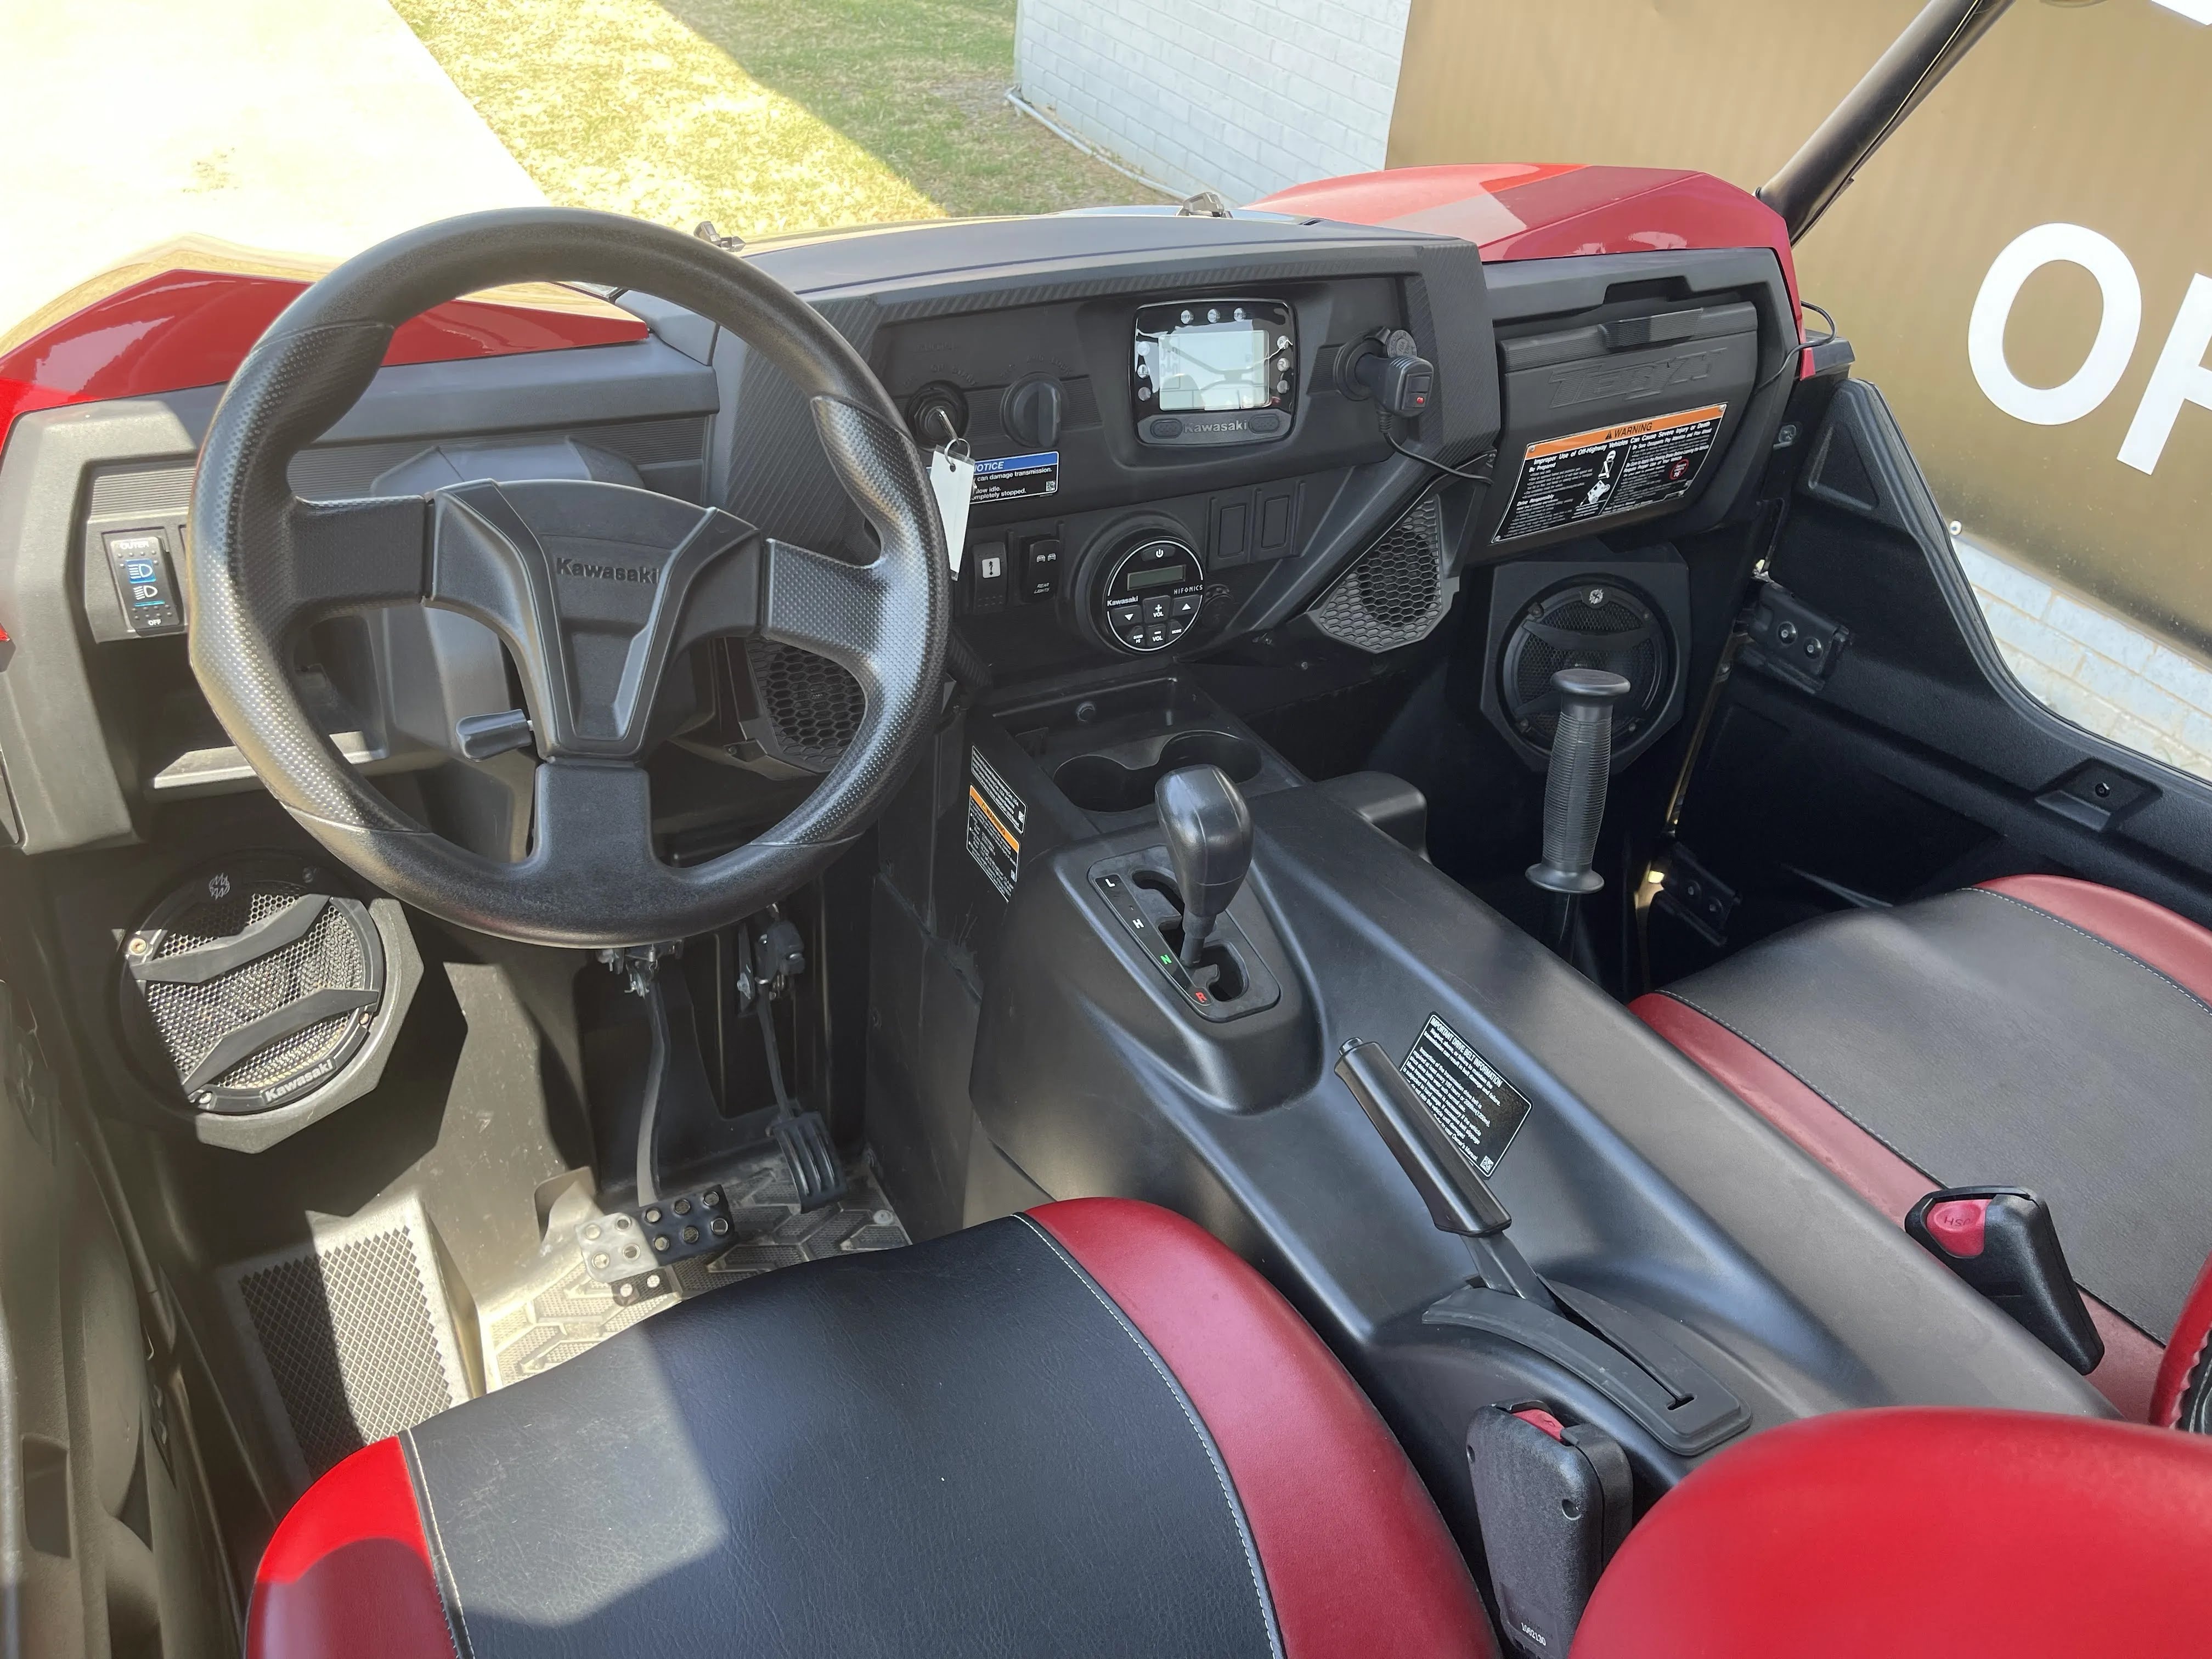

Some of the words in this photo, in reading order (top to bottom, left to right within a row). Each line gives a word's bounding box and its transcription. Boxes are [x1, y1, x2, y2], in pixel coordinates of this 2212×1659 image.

[1184, 420, 1247, 433] Kawasaki
[1614, 422, 1652, 438] WARNING
[1578, 445, 1607, 455] Off-Highway
[990, 472, 1013, 481] damage
[1014, 467, 1052, 477] transmission.
[972, 491, 1000, 500] ompletely
[1001, 488, 1027, 496] stopped.
[556, 557, 658, 584] Kawasaki
[1173, 584, 1203, 595] HIFONICS
[1107, 596, 1138, 606] Kawasaki
[1105, 879, 1115, 887] L
[1132, 919, 1144, 929] H
[1160, 955, 1172, 964] N
[1195, 992, 1207, 1003] R
[1431, 1018, 1453, 1041] IMPORTANT
[1452, 1037, 1465, 1053] DRIVE
[1463, 1048, 1475, 1062] BELT
[1474, 1058, 1502, 1087] INFORMATION
[266, 1060, 333, 1102] Kawasaki
[1521, 1622, 1546, 1646] 1062130
